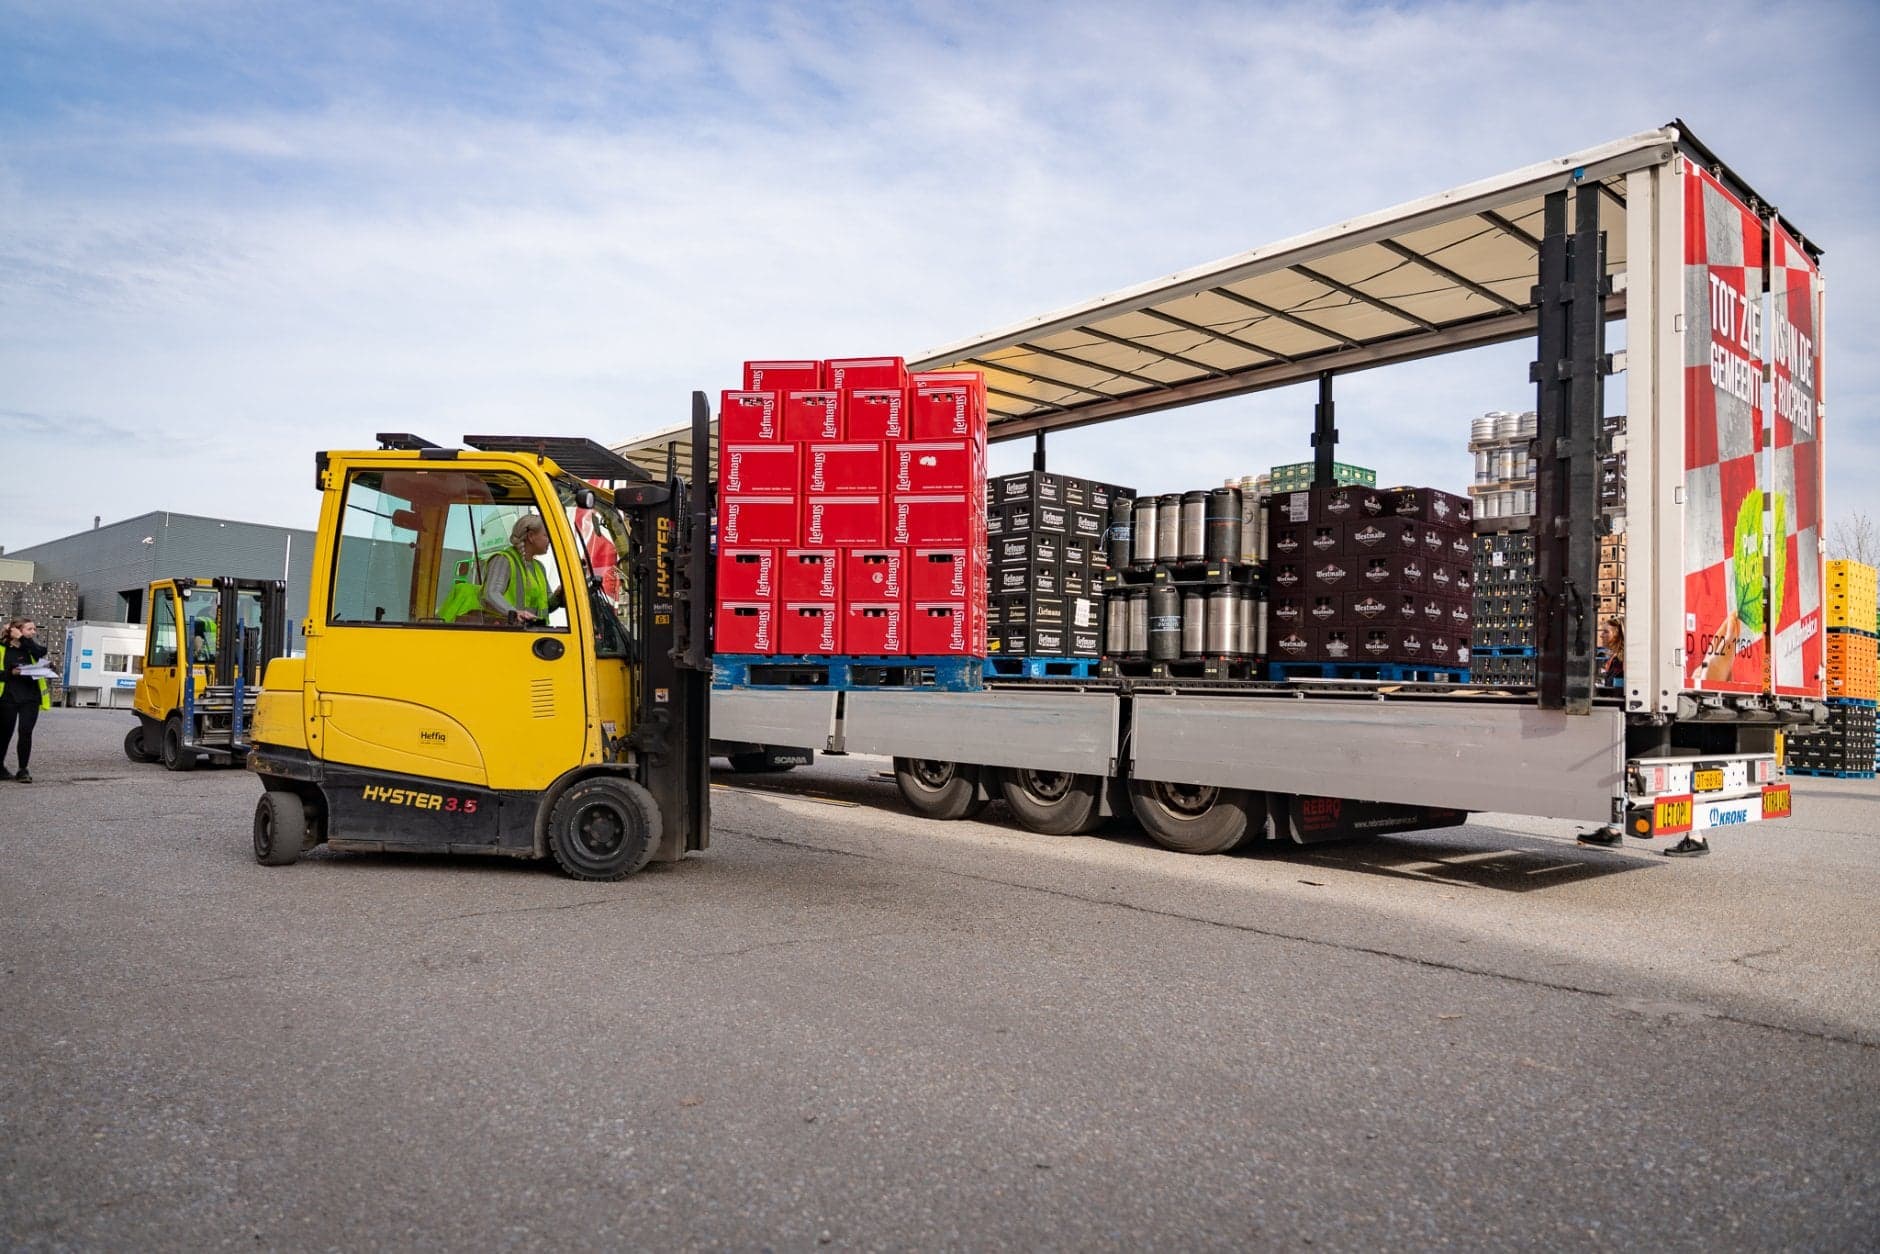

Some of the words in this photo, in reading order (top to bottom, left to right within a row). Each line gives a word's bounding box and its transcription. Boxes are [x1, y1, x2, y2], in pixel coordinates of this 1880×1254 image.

[1709, 272, 1738, 341] TOT
[1787, 321, 1798, 376] IN
[1799, 332, 1812, 388] DE
[1778, 374, 1812, 436] RUCPHEN
[774, 755, 807, 764] SCANIA
[362, 784, 443, 811] HYSTER
[444, 797, 478, 813] 3.5
[1662, 803, 1675, 828] LET
[1719, 809, 1747, 825] KRONE
